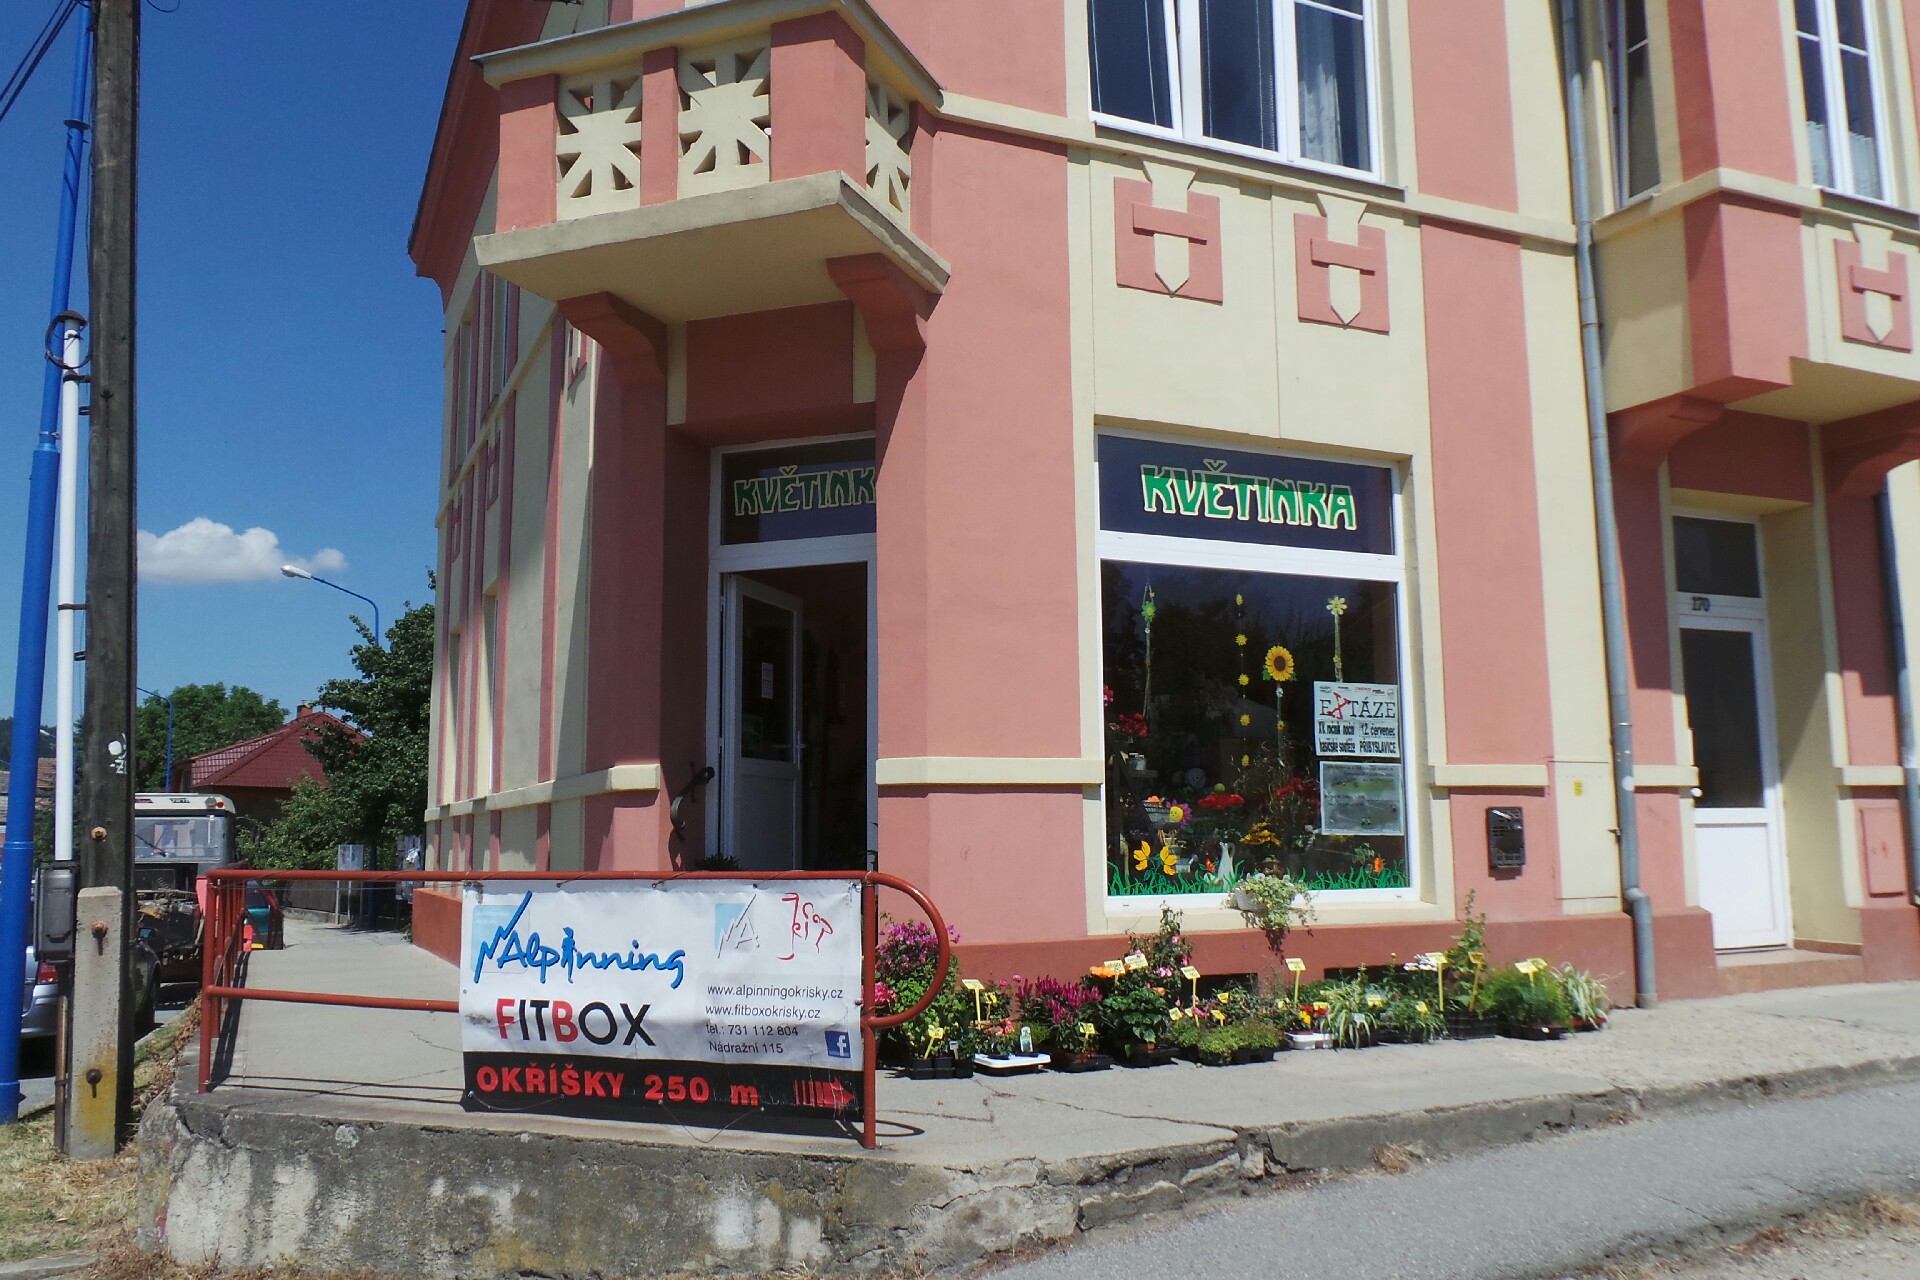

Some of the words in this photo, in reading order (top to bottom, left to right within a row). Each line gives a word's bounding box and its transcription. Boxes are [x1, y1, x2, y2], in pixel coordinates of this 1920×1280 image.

[734, 465, 876, 516] KVĚTINK
[1140, 458, 1357, 531] KVĚTINKA
[707, 984, 844, 1001] www.alpinningokrisky.cz
[496, 997, 656, 1047] FITBOX
[705, 1004, 821, 1021] www.fitboxokrisky.cz
[706, 1024, 725, 1035] tel.:
[728, 1024, 748, 1036] 731
[753, 1025, 774, 1036] 112
[777, 1025, 799, 1036] 804
[708, 1041, 759, 1054] Nádražní
[763, 1043, 784, 1054] 115
[476, 1062, 625, 1099] OKŘÍŠKY
[644, 1075, 711, 1103] 250
[731, 1085, 759, 1106] m
